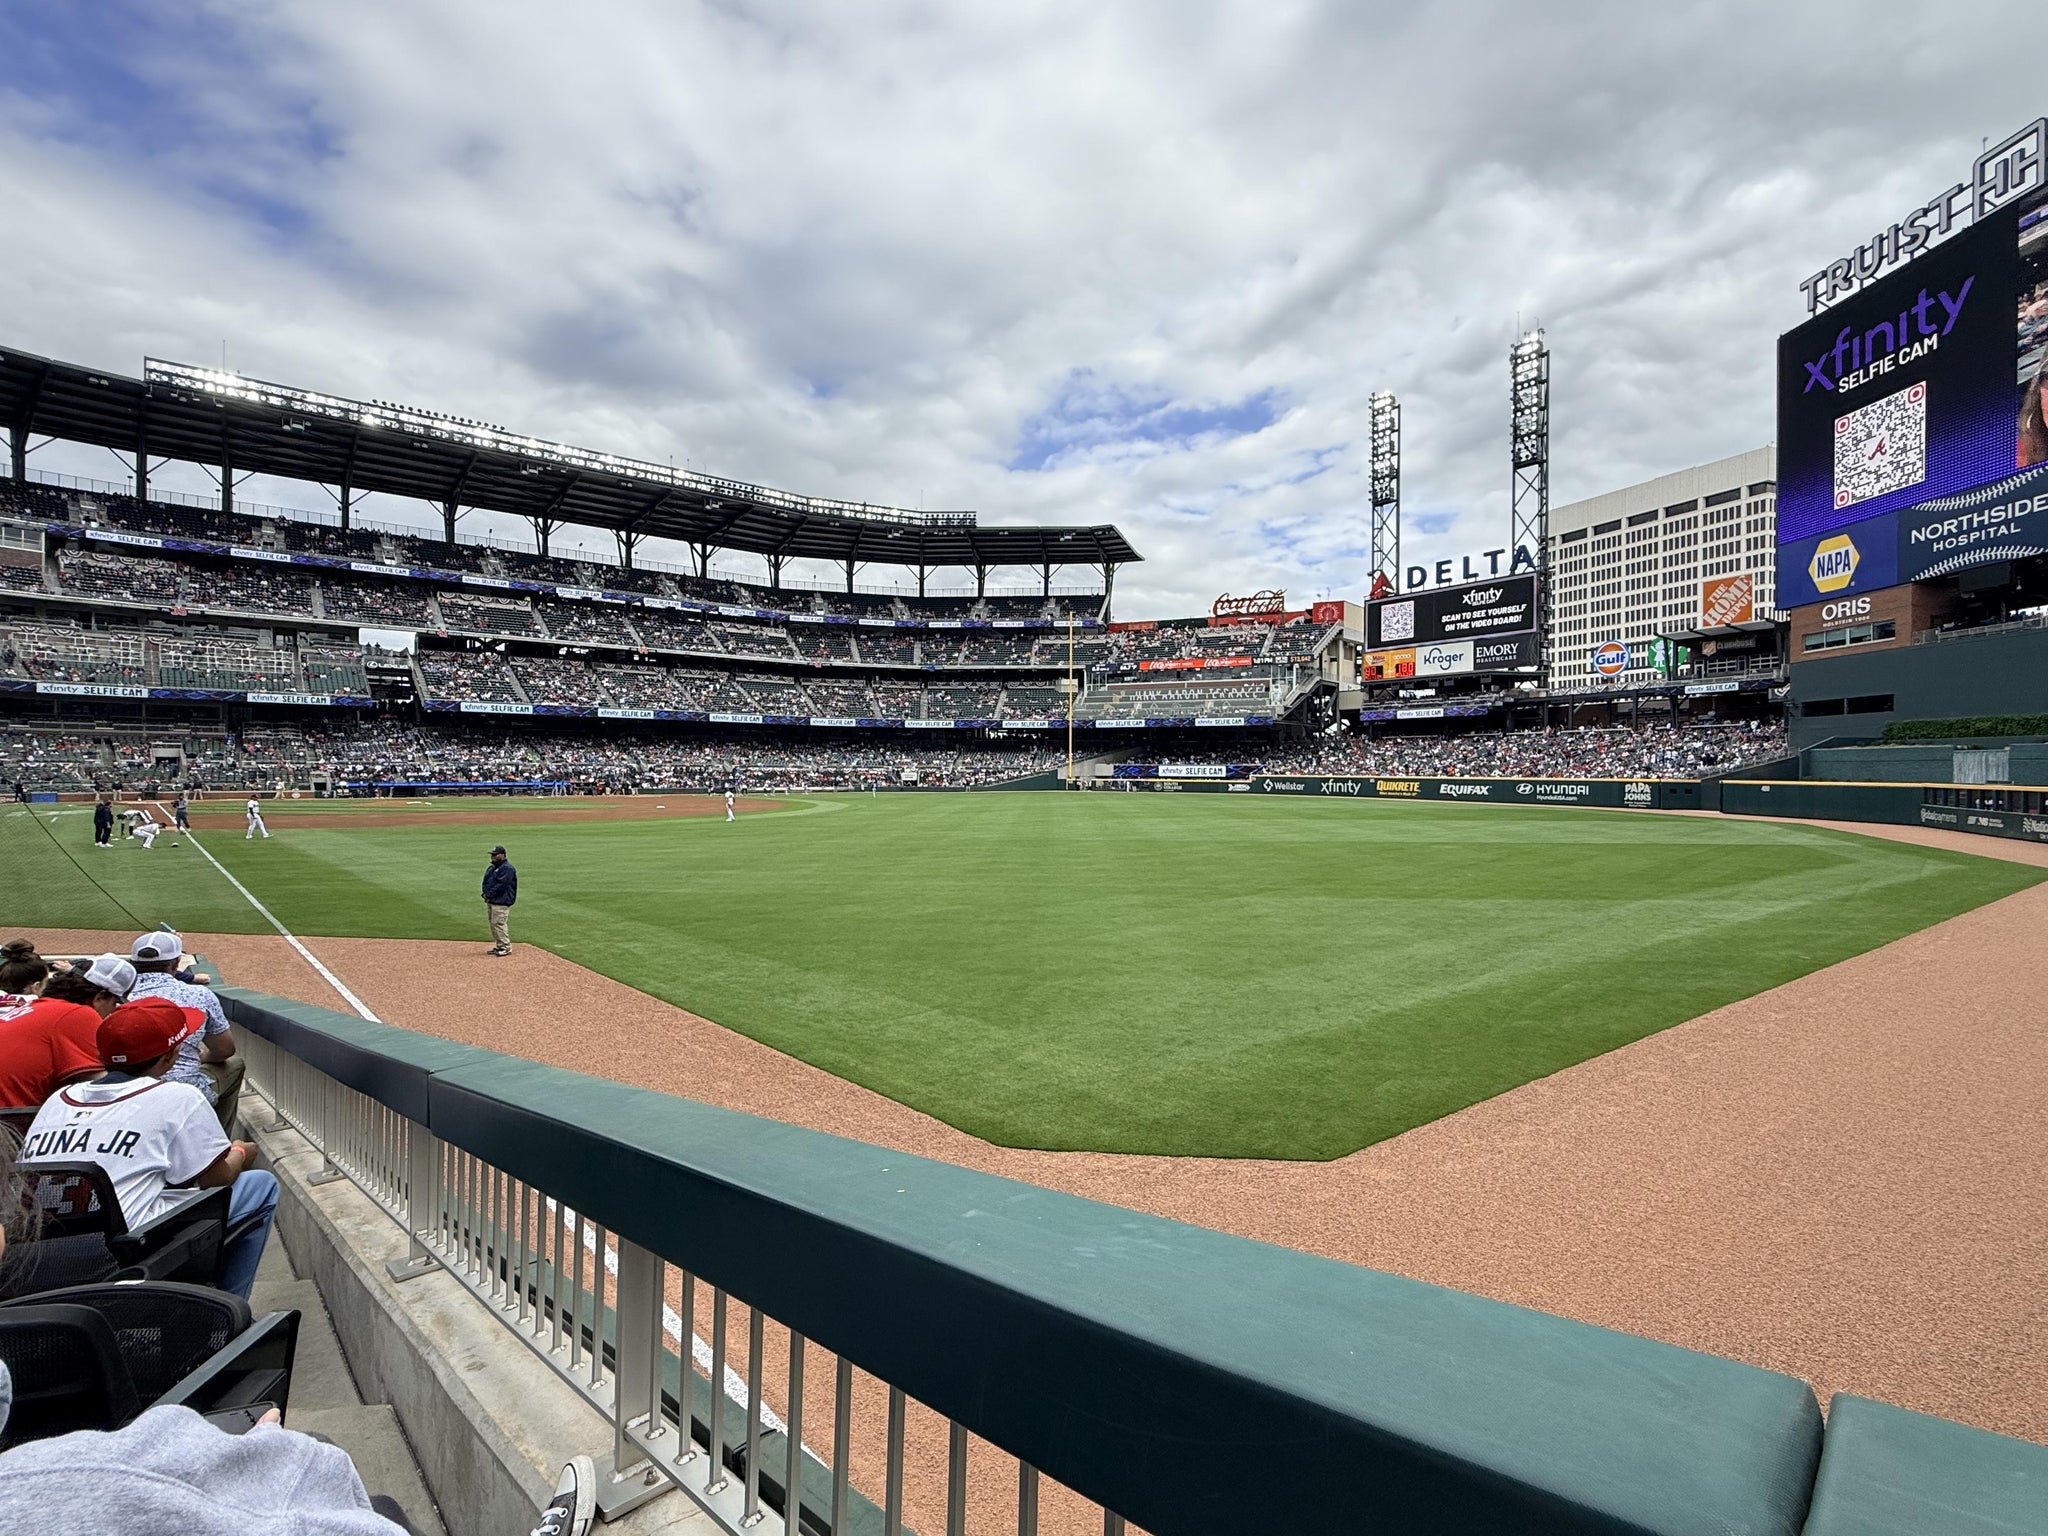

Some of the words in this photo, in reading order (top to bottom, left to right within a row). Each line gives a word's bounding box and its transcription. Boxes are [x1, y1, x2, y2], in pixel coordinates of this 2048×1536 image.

[1800, 183, 1963, 312] TRUIST
[1803, 275, 1976, 393] xfinity
[1838, 354, 1895, 394] SELFIE
[1899, 333, 1938, 365] CAM
[1911, 493, 2048, 545] NORTHSIDE
[118, 536, 140, 544] SELFIE
[144, 538, 158, 546] CAM
[1933, 522, 2022, 553] HOSPITAL
[1407, 544, 1536, 589] DELTA
[1817, 549, 1851, 579] NAPA
[1462, 588, 1504, 605] xfinity
[1703, 576, 1751, 626] HOME
[1707, 583, 1728, 604] THE
[1441, 613, 1461, 623] SCAN
[1462, 612, 1471, 620] TO
[1472, 610, 1487, 619] SEE
[1488, 604, 1527, 616] YOURSELF
[1721, 591, 1752, 624] DEPOT
[1822, 597, 1871, 620] ORIS
[1445, 623, 1456, 632] ON
[1456, 622, 1470, 630] THE
[1471, 618, 1492, 629] VIDEO
[1493, 615, 1522, 626] BOARD!
[1424, 647, 1464, 670] Kroger
[1476, 642, 1519, 658] EMORY
[1596, 652, 1626, 665] Gulf
[1476, 655, 1516, 663] HEALTHCARE
[43, 685, 79, 693] xfinity
[84, 687, 118, 696] SELFIE
[122, 688, 143, 697] CAM
[282, 695, 308, 703] SELFIE
[1185, 767, 1207, 775] SELFIE
[1208, 767, 1223, 775] CAM
[1274, 781, 1305, 791] Wellstar
[1321, 779, 1361, 795] xfinity
[1376, 780, 1420, 792] QUIKRETE
[1439, 783, 1489, 797] EQUIFAX
[1536, 784, 1589, 796] HYUNDAI
[1625, 783, 1651, 793] PAPA
[1624, 793, 1651, 801] JOHNS
[21, 1123, 92, 1160] CUÑA
[96, 1129, 142, 1159] JR.
